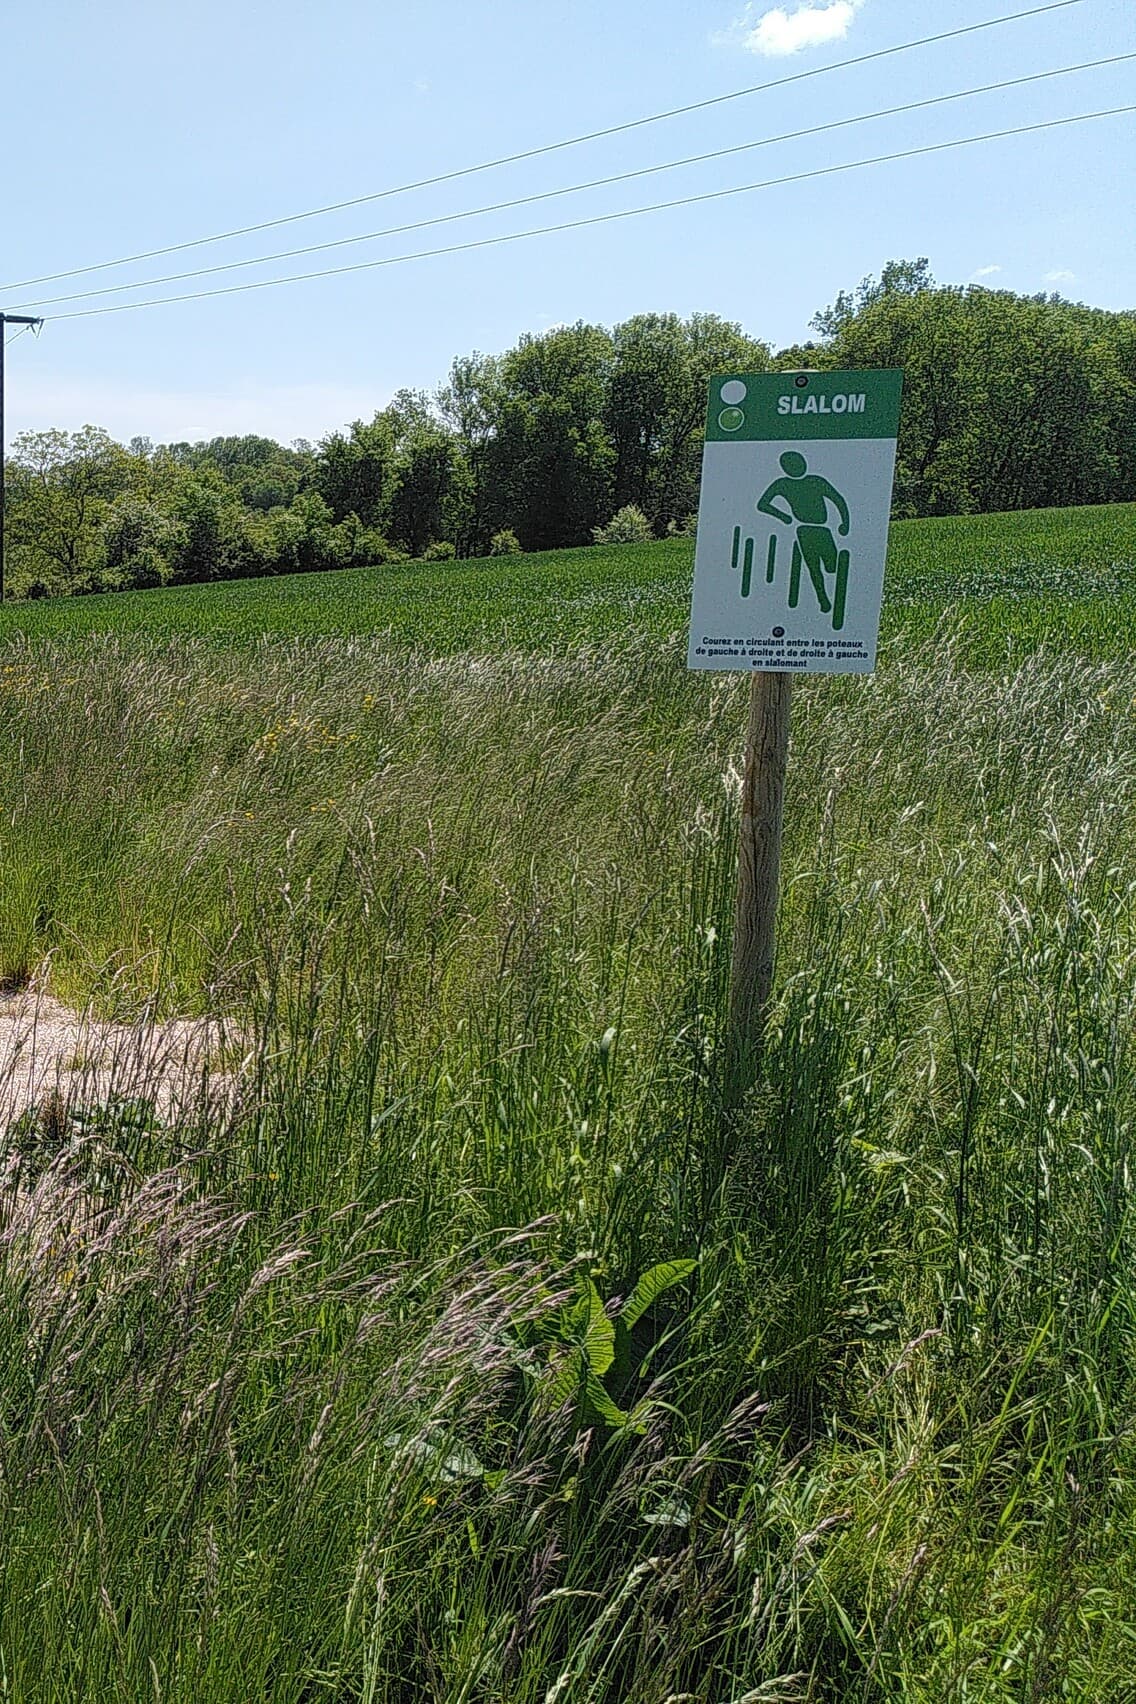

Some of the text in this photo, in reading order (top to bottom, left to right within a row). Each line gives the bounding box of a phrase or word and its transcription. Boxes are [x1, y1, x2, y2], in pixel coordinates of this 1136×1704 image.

[777, 394, 866, 415] SLALOM
[702, 636, 732, 646] Courez
[746, 637, 784, 646] circulant
[786, 639, 810, 647] entre
[811, 639, 825, 647] les
[827, 640, 863, 649] poteaux
[695, 647, 868, 659] de gauche à droite et de droite à gauche
[765, 658, 807, 667] slalomant
